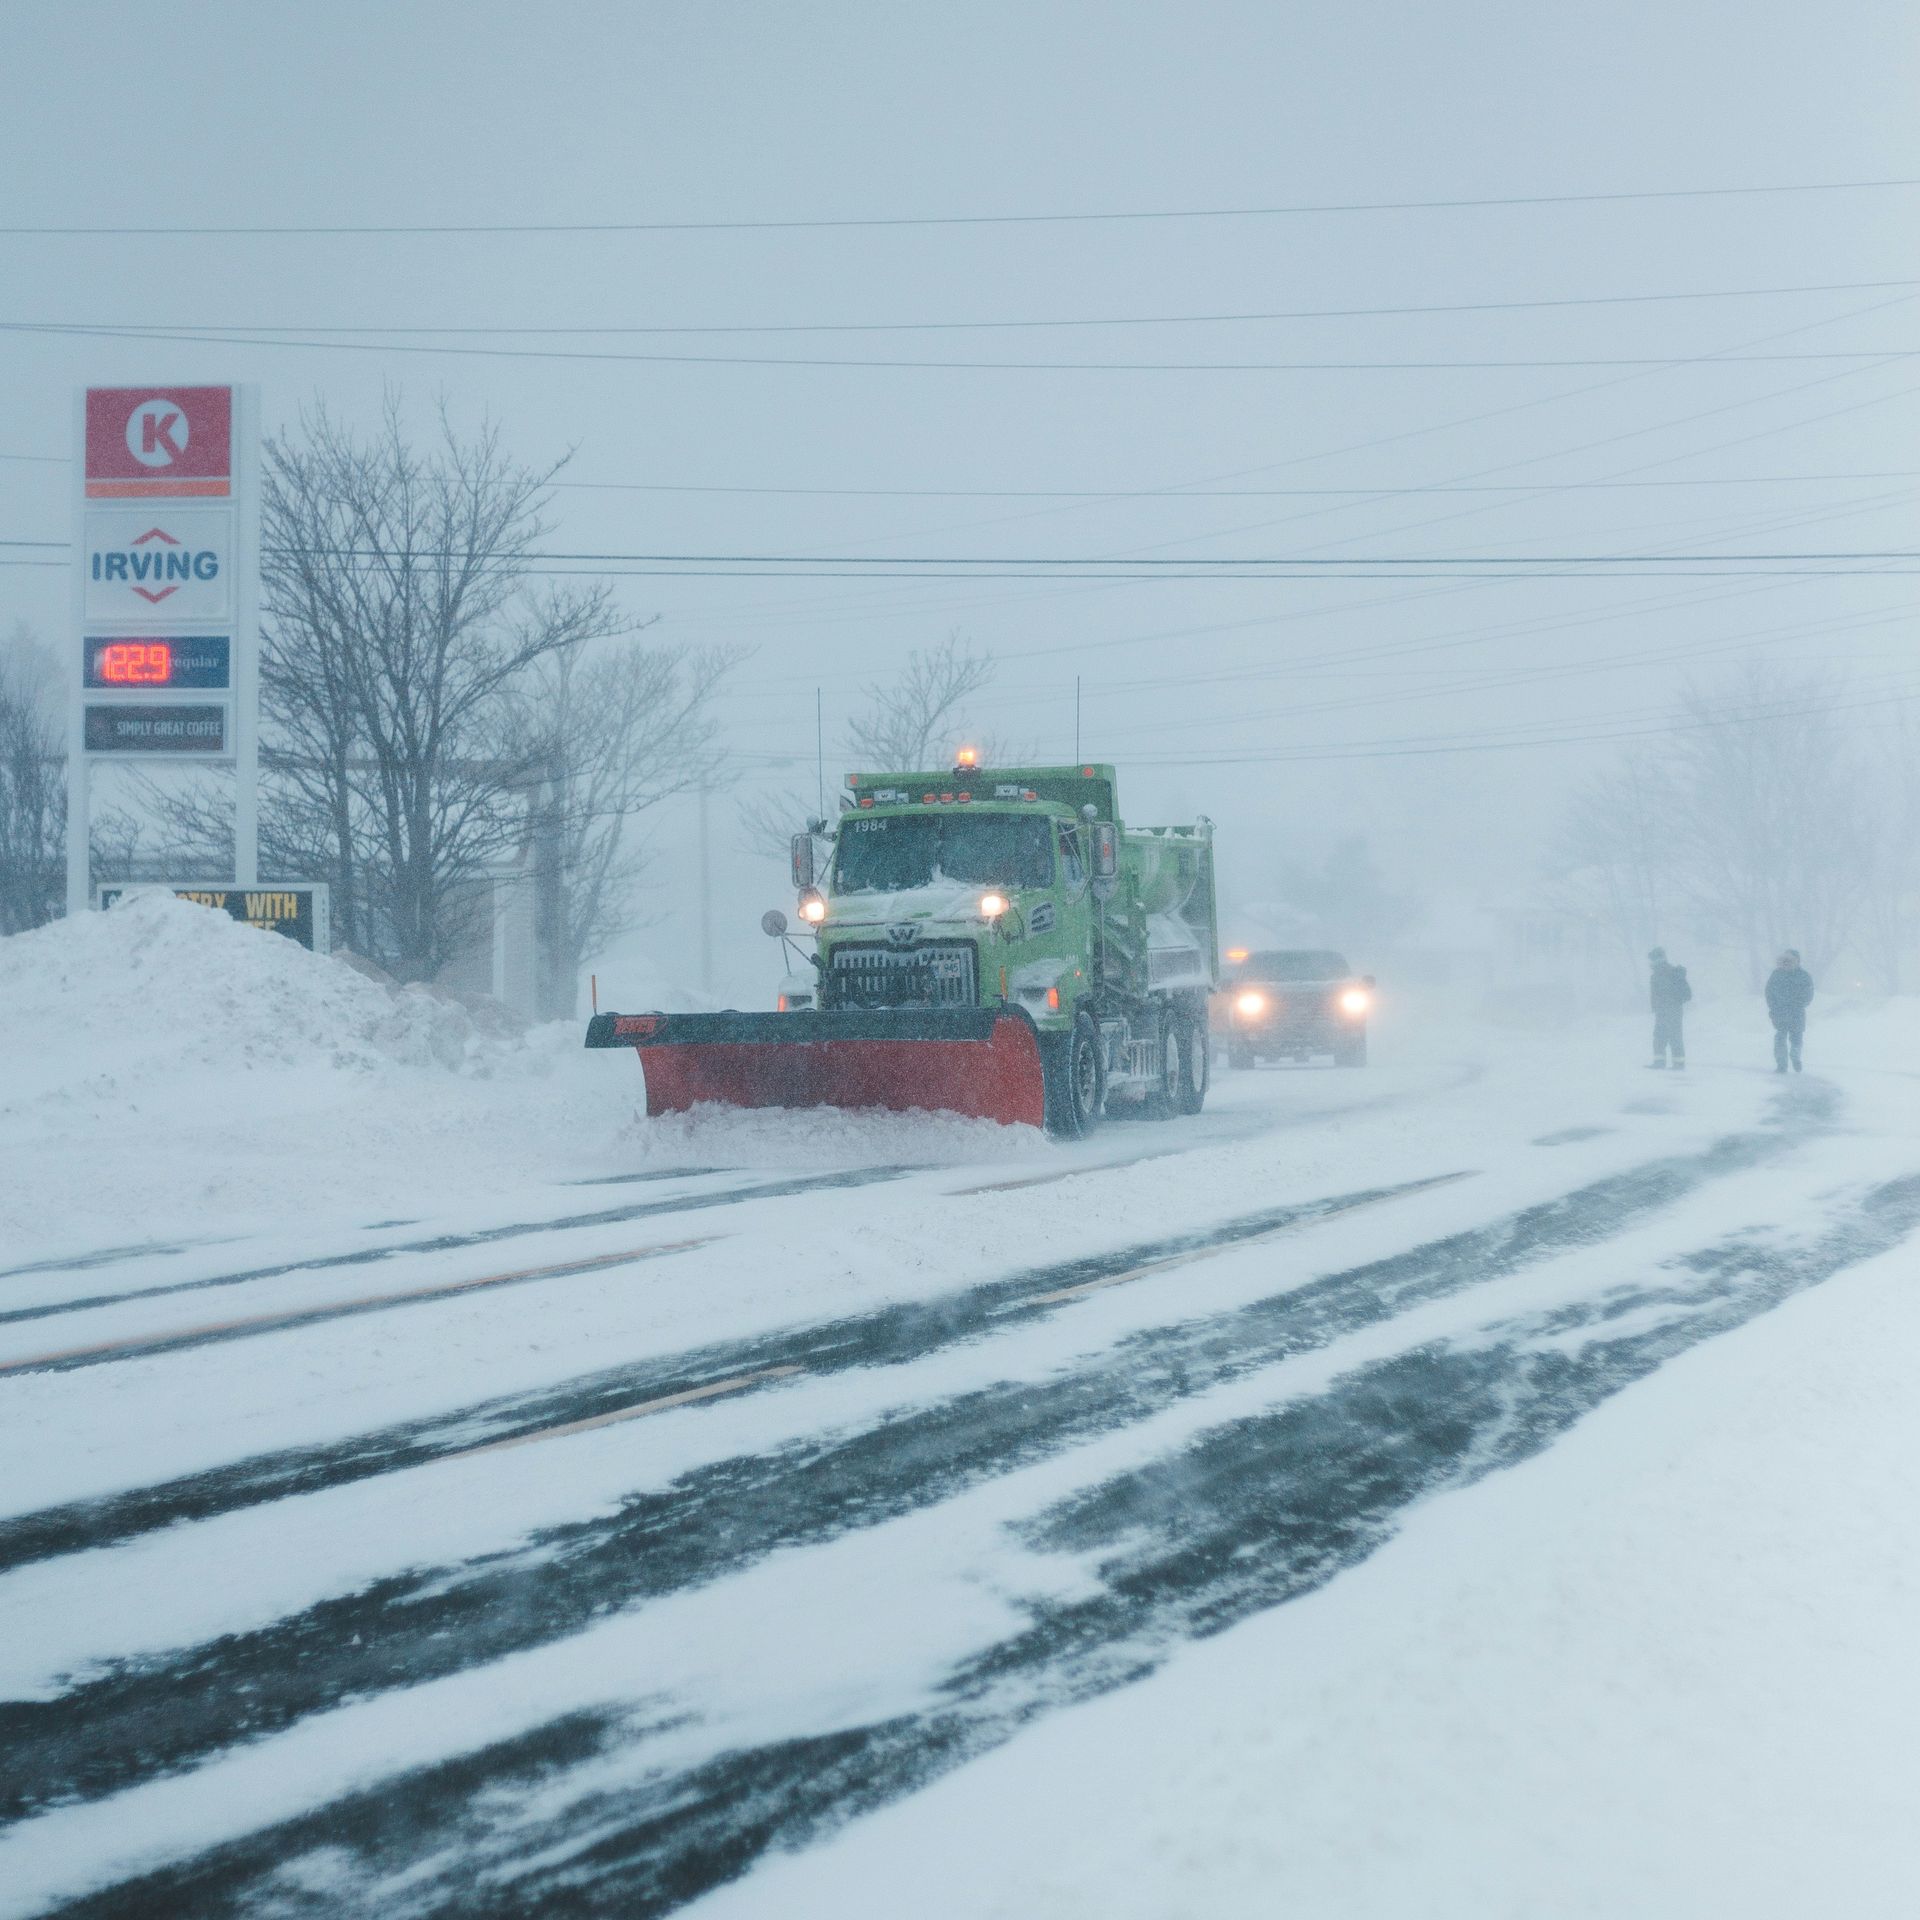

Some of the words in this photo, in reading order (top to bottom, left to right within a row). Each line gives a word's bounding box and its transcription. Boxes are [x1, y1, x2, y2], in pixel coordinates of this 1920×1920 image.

[142, 413, 182, 456] K
[92, 551, 219, 581] IRVING
[117, 720, 151, 736] SIMPLY
[154, 720, 185, 736] GREAT
[187, 720, 221, 736] COFFEE
[854, 820, 888, 833] 1984
[245, 892, 298, 919] WITH
